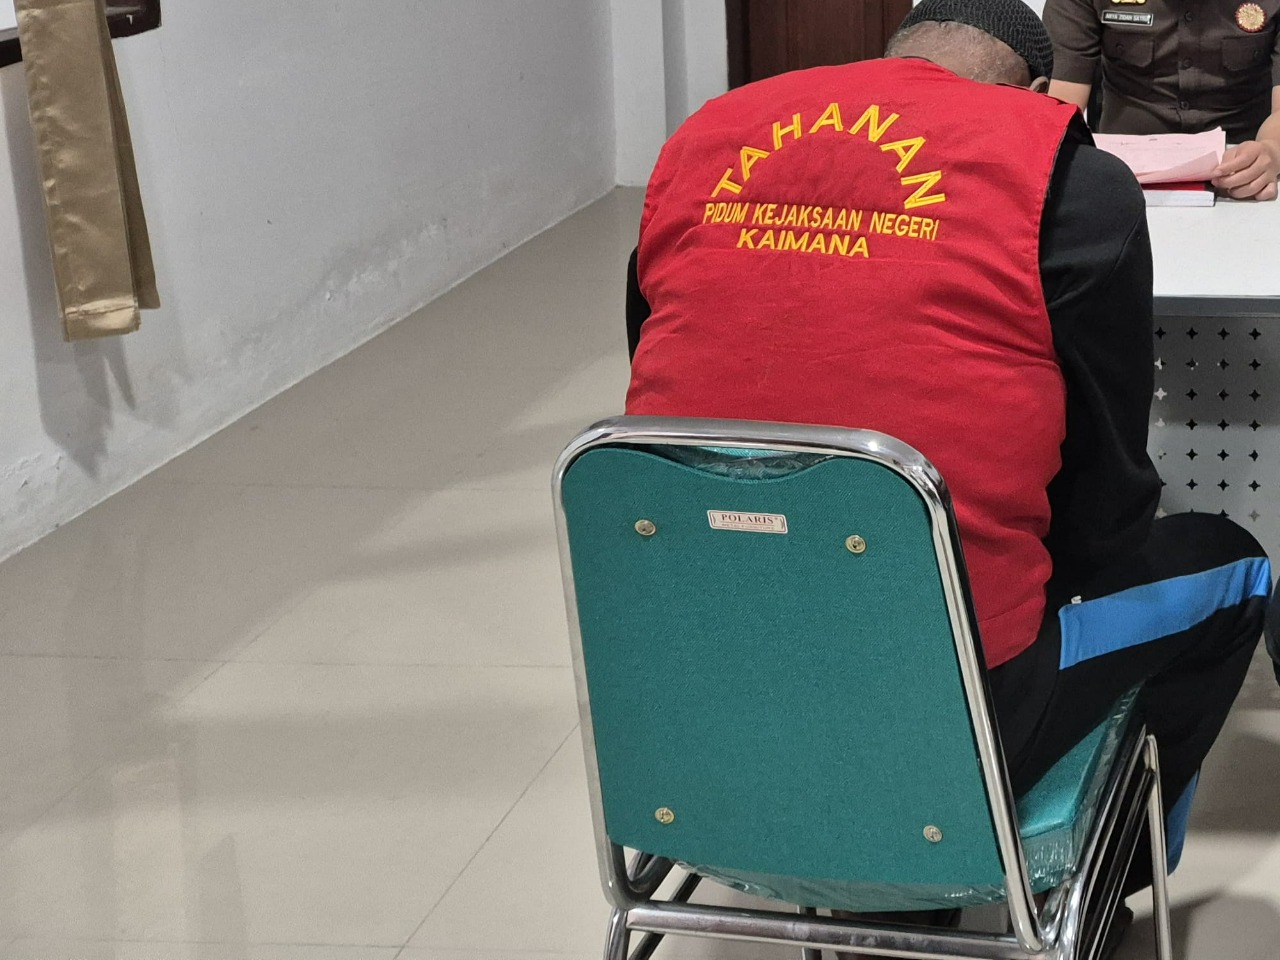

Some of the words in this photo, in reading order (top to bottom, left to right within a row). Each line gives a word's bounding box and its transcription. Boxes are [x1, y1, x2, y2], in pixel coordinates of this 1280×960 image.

[710, 102, 947, 210] TAHANAN
[702, 202, 749, 225] PIDUM
[751, 203, 863, 232] KEJAKSAAN
[869, 211, 940, 241] NEGERI
[736, 228, 870, 259] KAIMANA
[721, 514, 774, 524] POLARIS
